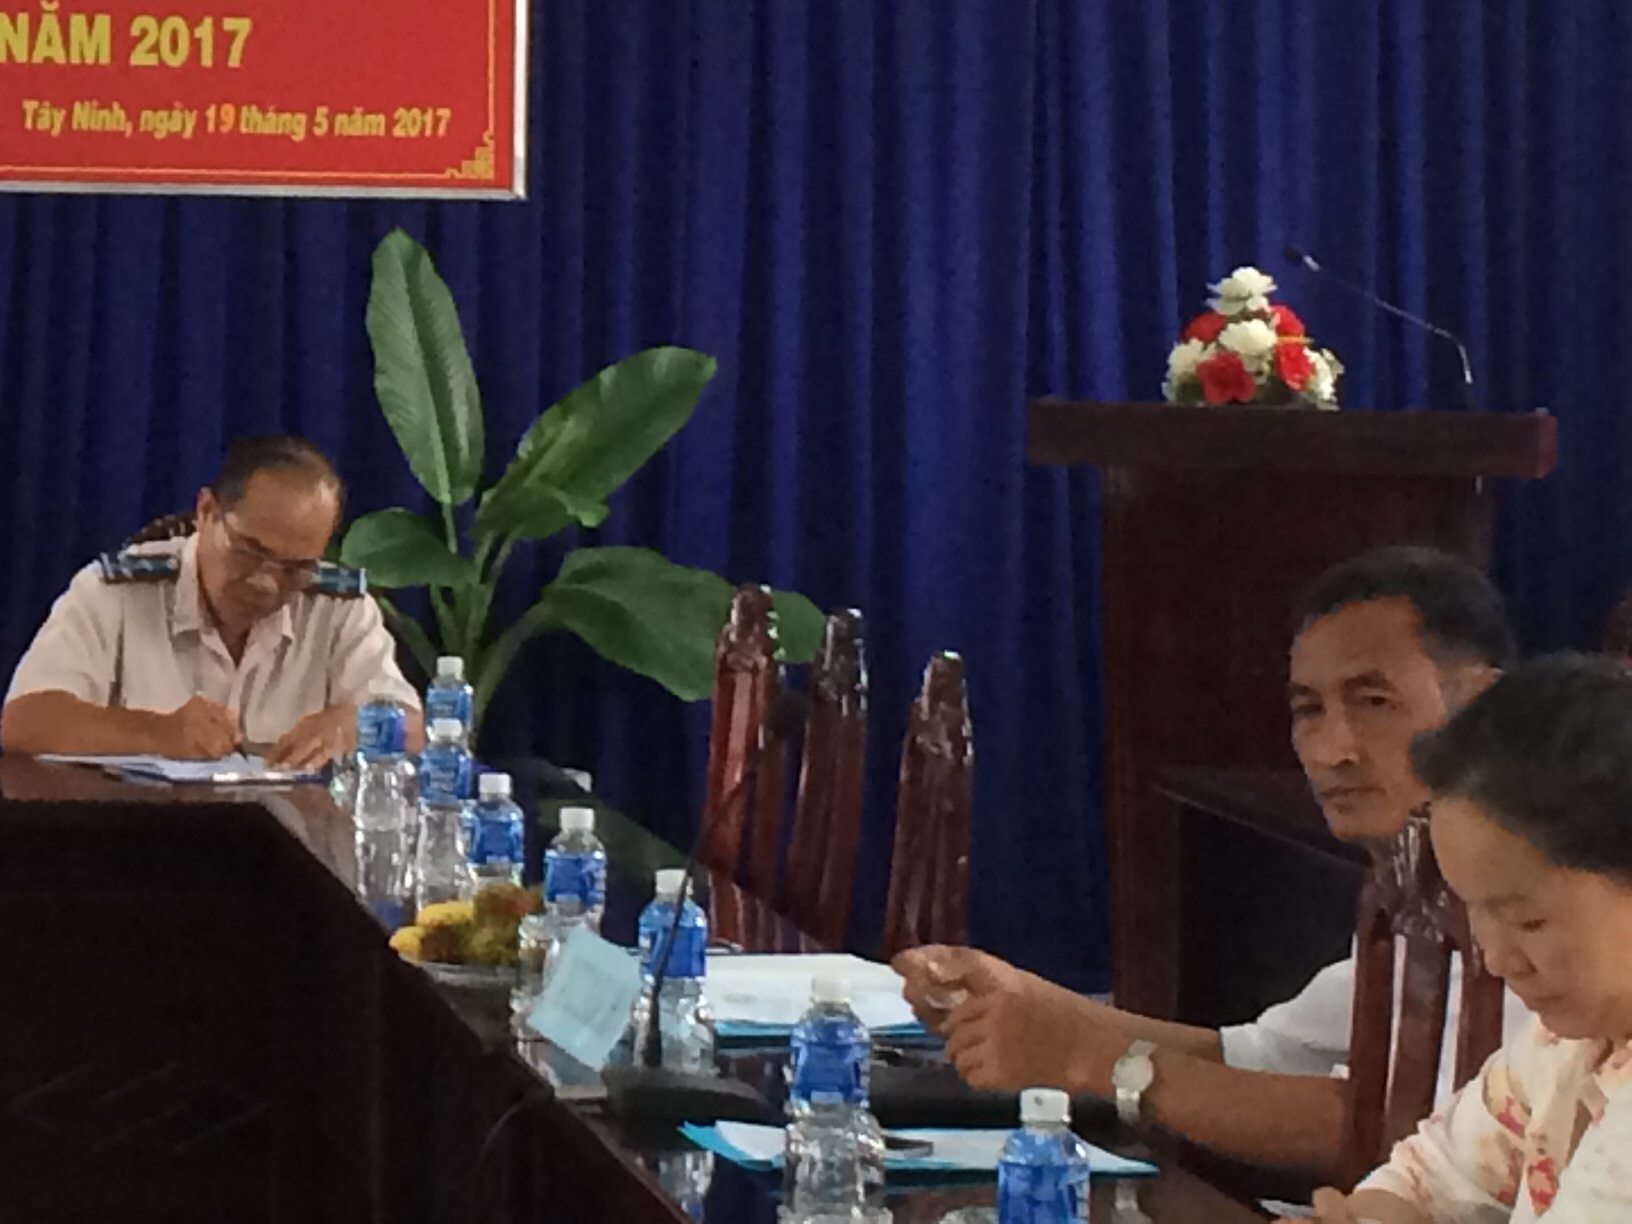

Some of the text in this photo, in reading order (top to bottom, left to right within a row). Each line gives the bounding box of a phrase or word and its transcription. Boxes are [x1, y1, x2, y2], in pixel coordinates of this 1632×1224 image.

[129, 14, 253, 68] 2017
[21, 98, 452, 142] Tây Ninh, ngày 19 tháng 5 năm 2017
